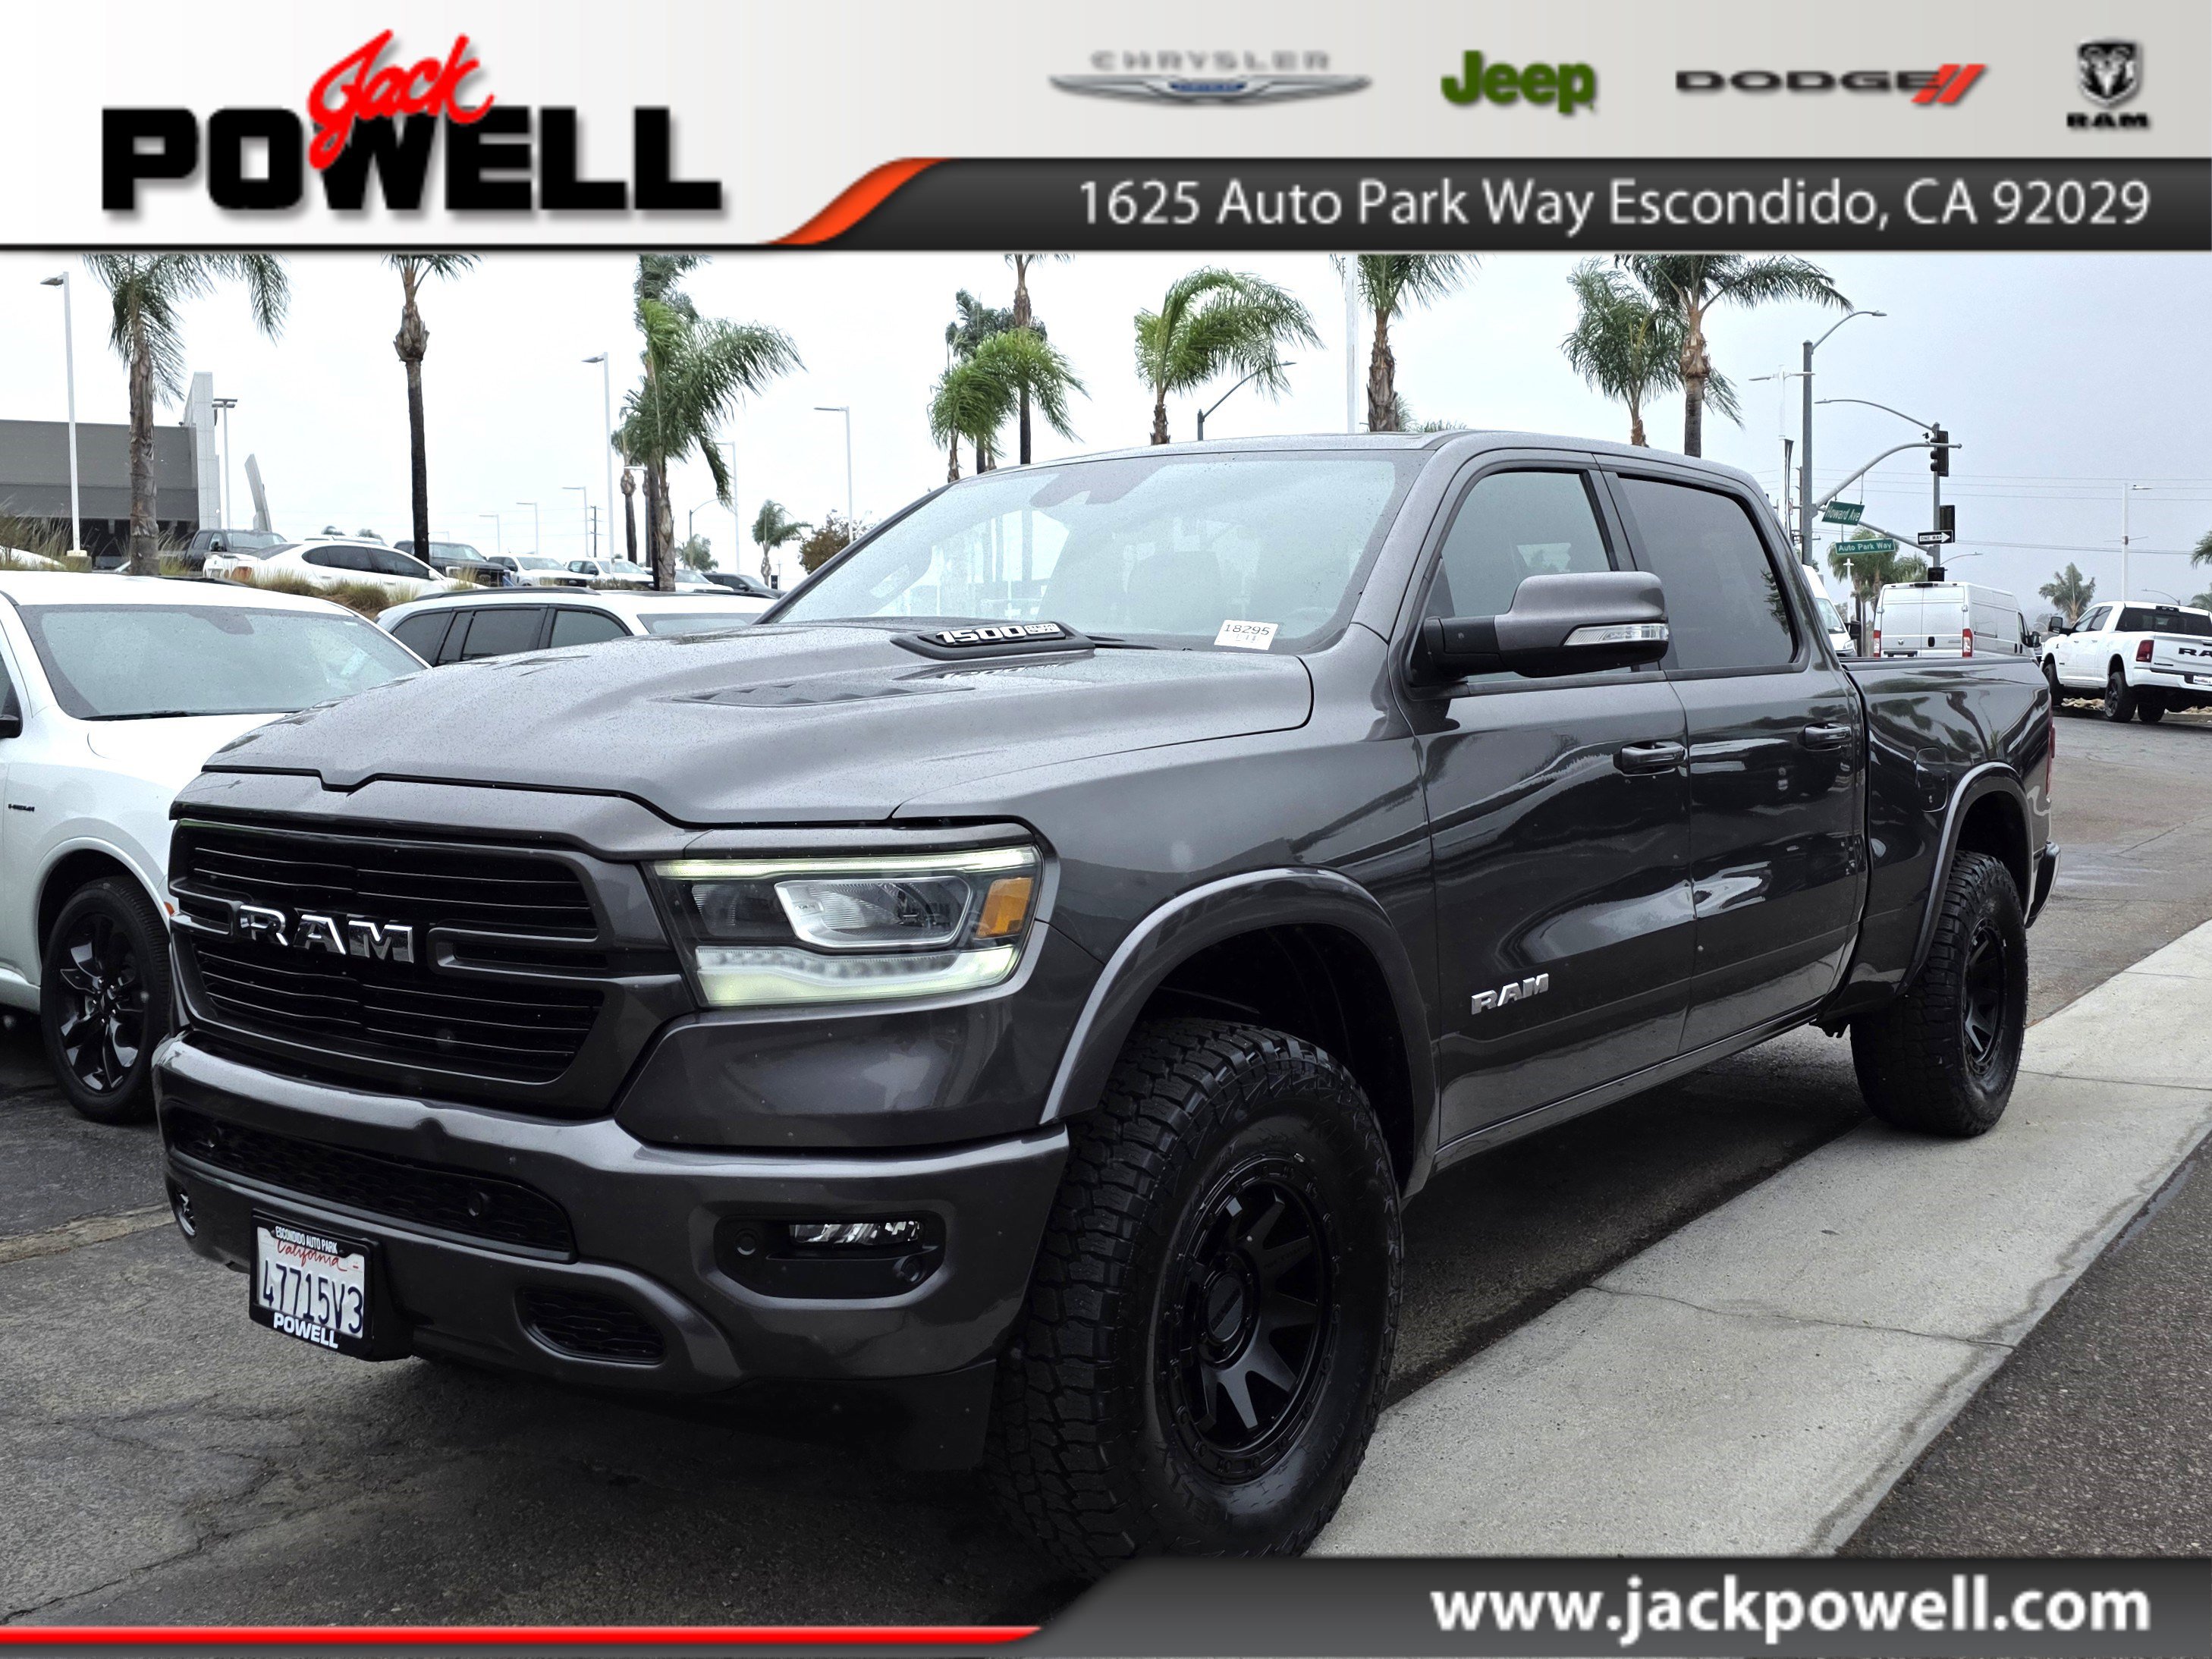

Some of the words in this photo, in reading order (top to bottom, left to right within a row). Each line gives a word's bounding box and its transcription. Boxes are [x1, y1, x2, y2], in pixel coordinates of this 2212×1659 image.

[1824, 506, 1850, 520] Howard
[1848, 509, 1861, 521] Ave
[935, 625, 1027, 644] 1500
[1224, 624, 1271, 636] 18295
[240, 904, 415, 963] RAM
[1471, 972, 1549, 1015] RAM
[276, 1239, 348, 1272] California
[306, 1235, 322, 1250] AUTO
[321, 1239, 338, 1255] PARK
[263, 1259, 363, 1334] 47715V3
[273, 1312, 339, 1350] POWELL
